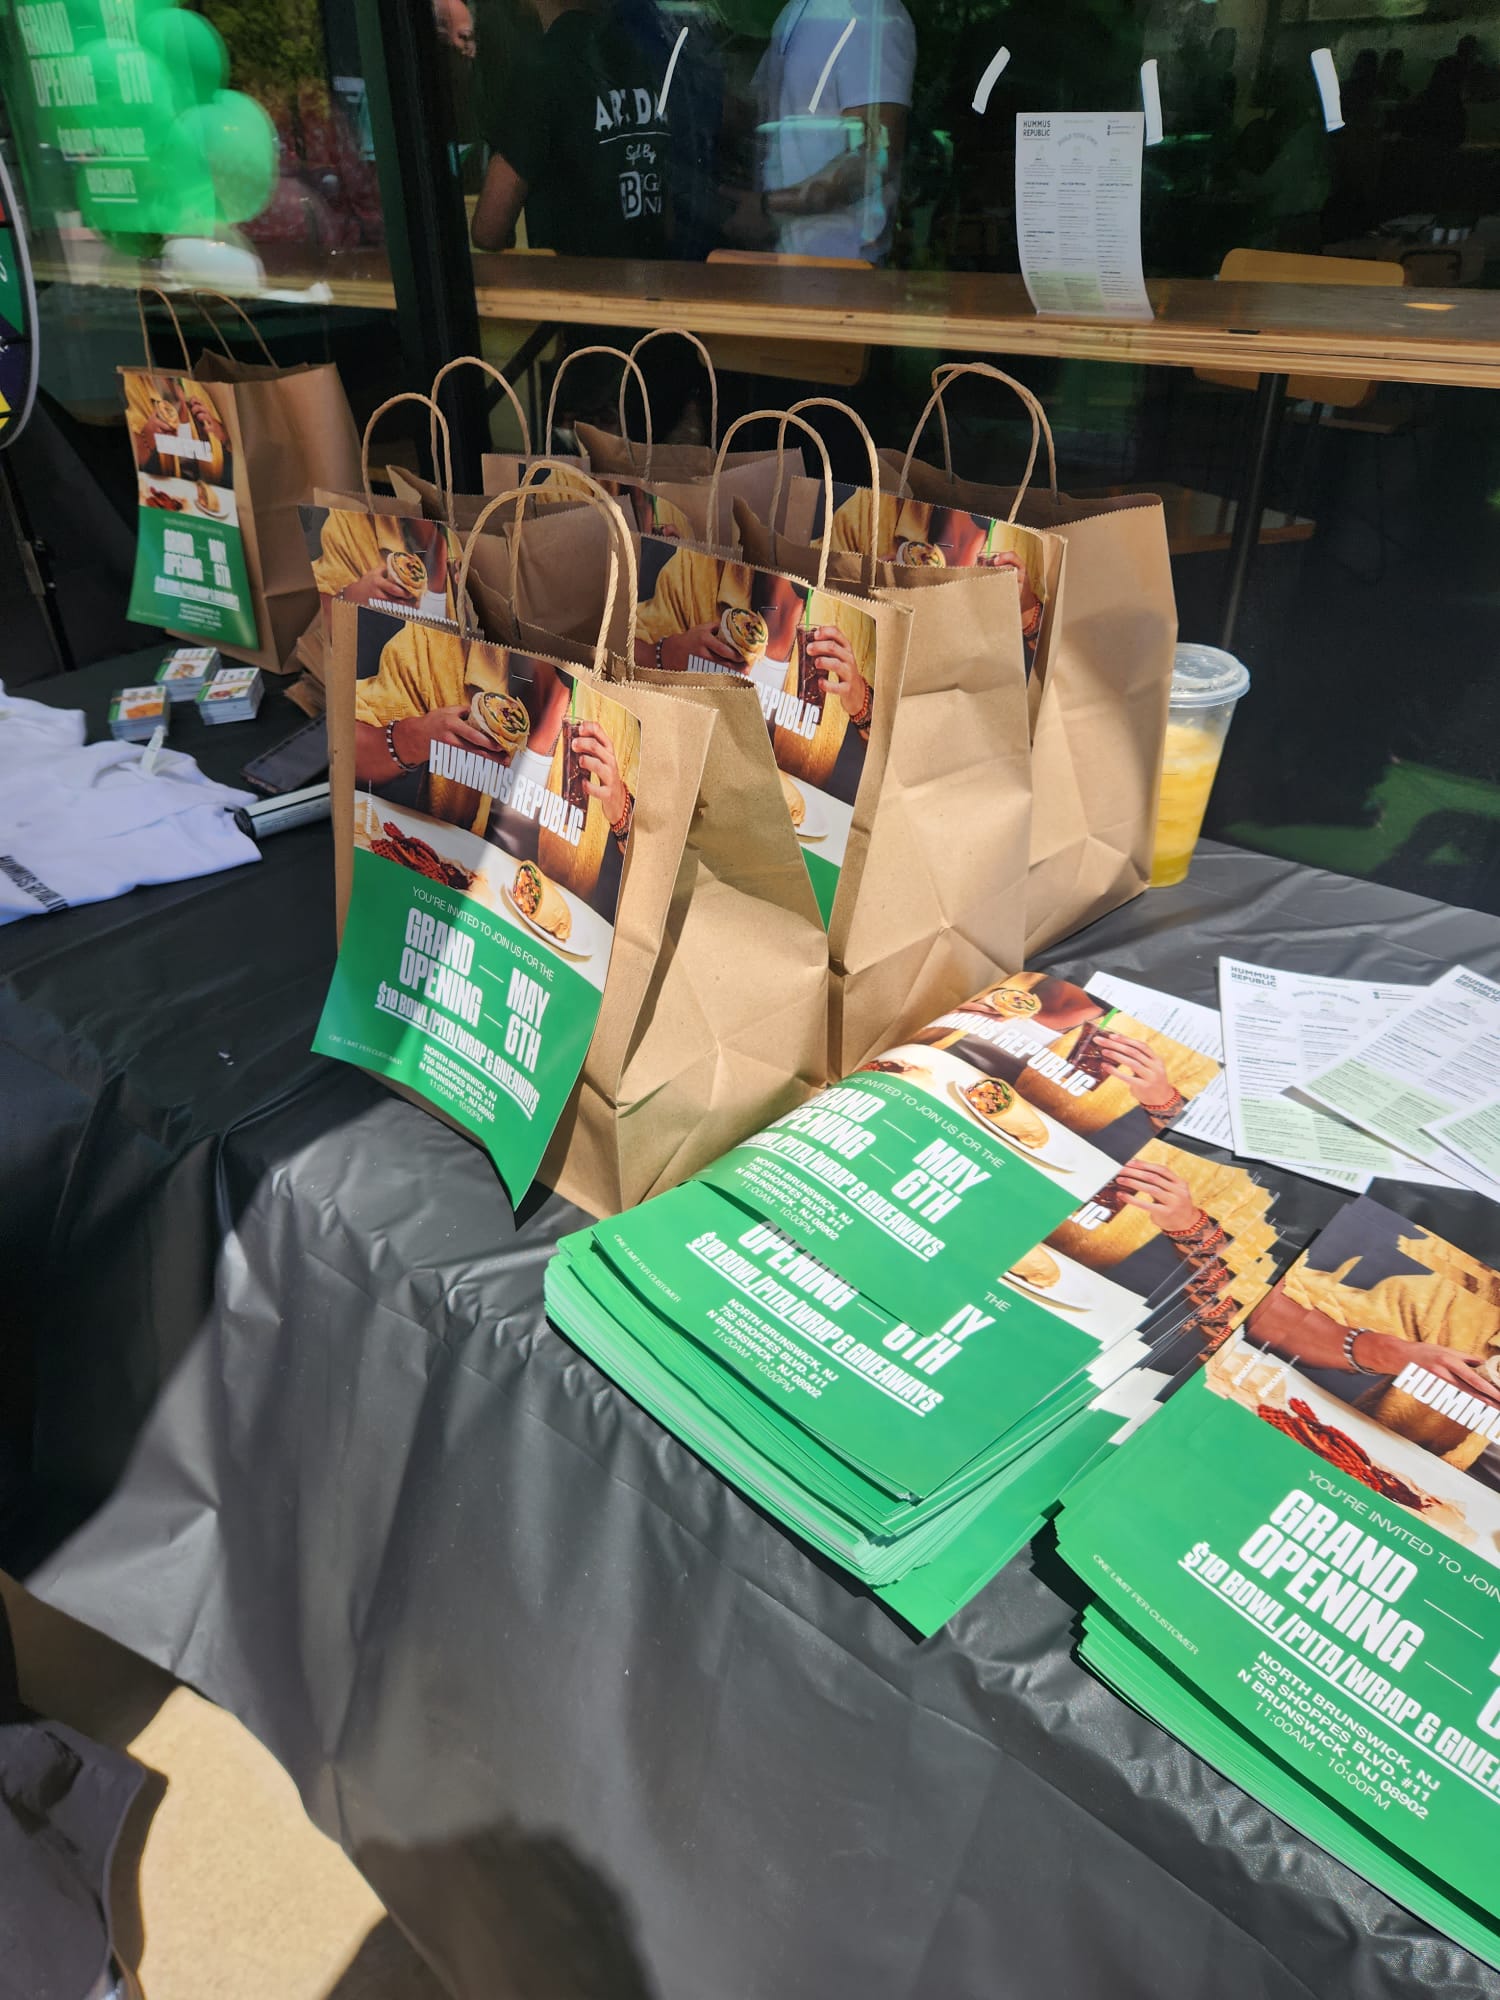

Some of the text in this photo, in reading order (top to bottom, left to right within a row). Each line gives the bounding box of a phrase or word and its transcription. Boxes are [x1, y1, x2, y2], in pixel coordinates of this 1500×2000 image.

[1023, 120, 1051, 128] HUMMUS
[1023, 129, 1051, 137] REPUBLIC
[428, 738, 585, 848] HUMMUS REPUBLIC
[405, 907, 475, 977] GRAND
[413, 886, 555, 981] YOU'RE INVITED TO JOIN US FOR THE
[399, 947, 483, 1028] OPENING
[506, 967, 550, 1030] MAY
[1231, 966, 1276, 982] HUMMUS
[424, 1044, 448, 1064] NORTH
[488, 1089, 497, 1102] NJ
[504, 1013, 542, 1073] 6TH
[992, 1027, 1097, 1097] REPUBLIC
[468, 1096, 478, 1108] NJ
[492, 1055, 540, 1115] GIVEAWAYS
[799, 1087, 887, 1123] RAND
[766, 1107, 877, 1161] PENING
[864, 1079, 1006, 1168] INVITED TO JOIN US FOR THE
[753, 1156, 785, 1179] NORTH
[838, 1212, 854, 1226] NJ
[761, 1165, 802, 1199] SHOPPES
[891, 1168, 963, 1224] 6TH
[912, 1137, 992, 1195] MAY
[779, 1206, 816, 1236] 10:00PM
[799, 1207, 813, 1221] NJ
[811, 1218, 839, 1241] 08902
[847, 1181, 868, 1200] &
[858, 1190, 946, 1258] GIVEAWAYS
[738, 1220, 859, 1312] OPENING
[983, 1291, 1012, 1313] THE
[706, 1309, 716, 1320] N
[777, 1363, 793, 1377] NJ
[791, 1370, 822, 1398] 08902
[713, 1328, 749, 1360] 11:00AM
[755, 1361, 796, 1393] 10:00PM
[719, 1306, 828, 1389] 758 SHOPPES BLVD. #11
[728, 1299, 762, 1326] NORTH
[821, 1367, 839, 1382] NJ
[831, 1334, 855, 1354] &
[849, 1343, 944, 1412] GIVEAWAYS
[882, 1322, 964, 1376] 6TH
[1269, 1488, 1418, 1604] GRAND
[1308, 1469, 1368, 1515] YOU'RE
[1368, 1509, 1434, 1556] INVITED
[1437, 1551, 1462, 1573] TO
[1093, 1554, 1199, 1655] ONE LIMIT PER CUSTOMER
[1238, 1523, 1425, 1673] OPENING
[1237, 1669, 1252, 1684] N
[1355, 1761, 1380, 1782] NJ
[1379, 1779, 1430, 1820] 08902
[1251, 1662, 1431, 1802] 758 SHOPPES BLVD. #11
[1258, 1651, 1440, 1791] NORTH BRUNSWICK, NJ
[1414, 1711, 1441, 1743] &
[1255, 1702, 1316, 1752] 11:00AM
[1328, 1757, 1391, 1811] 10:00PM
